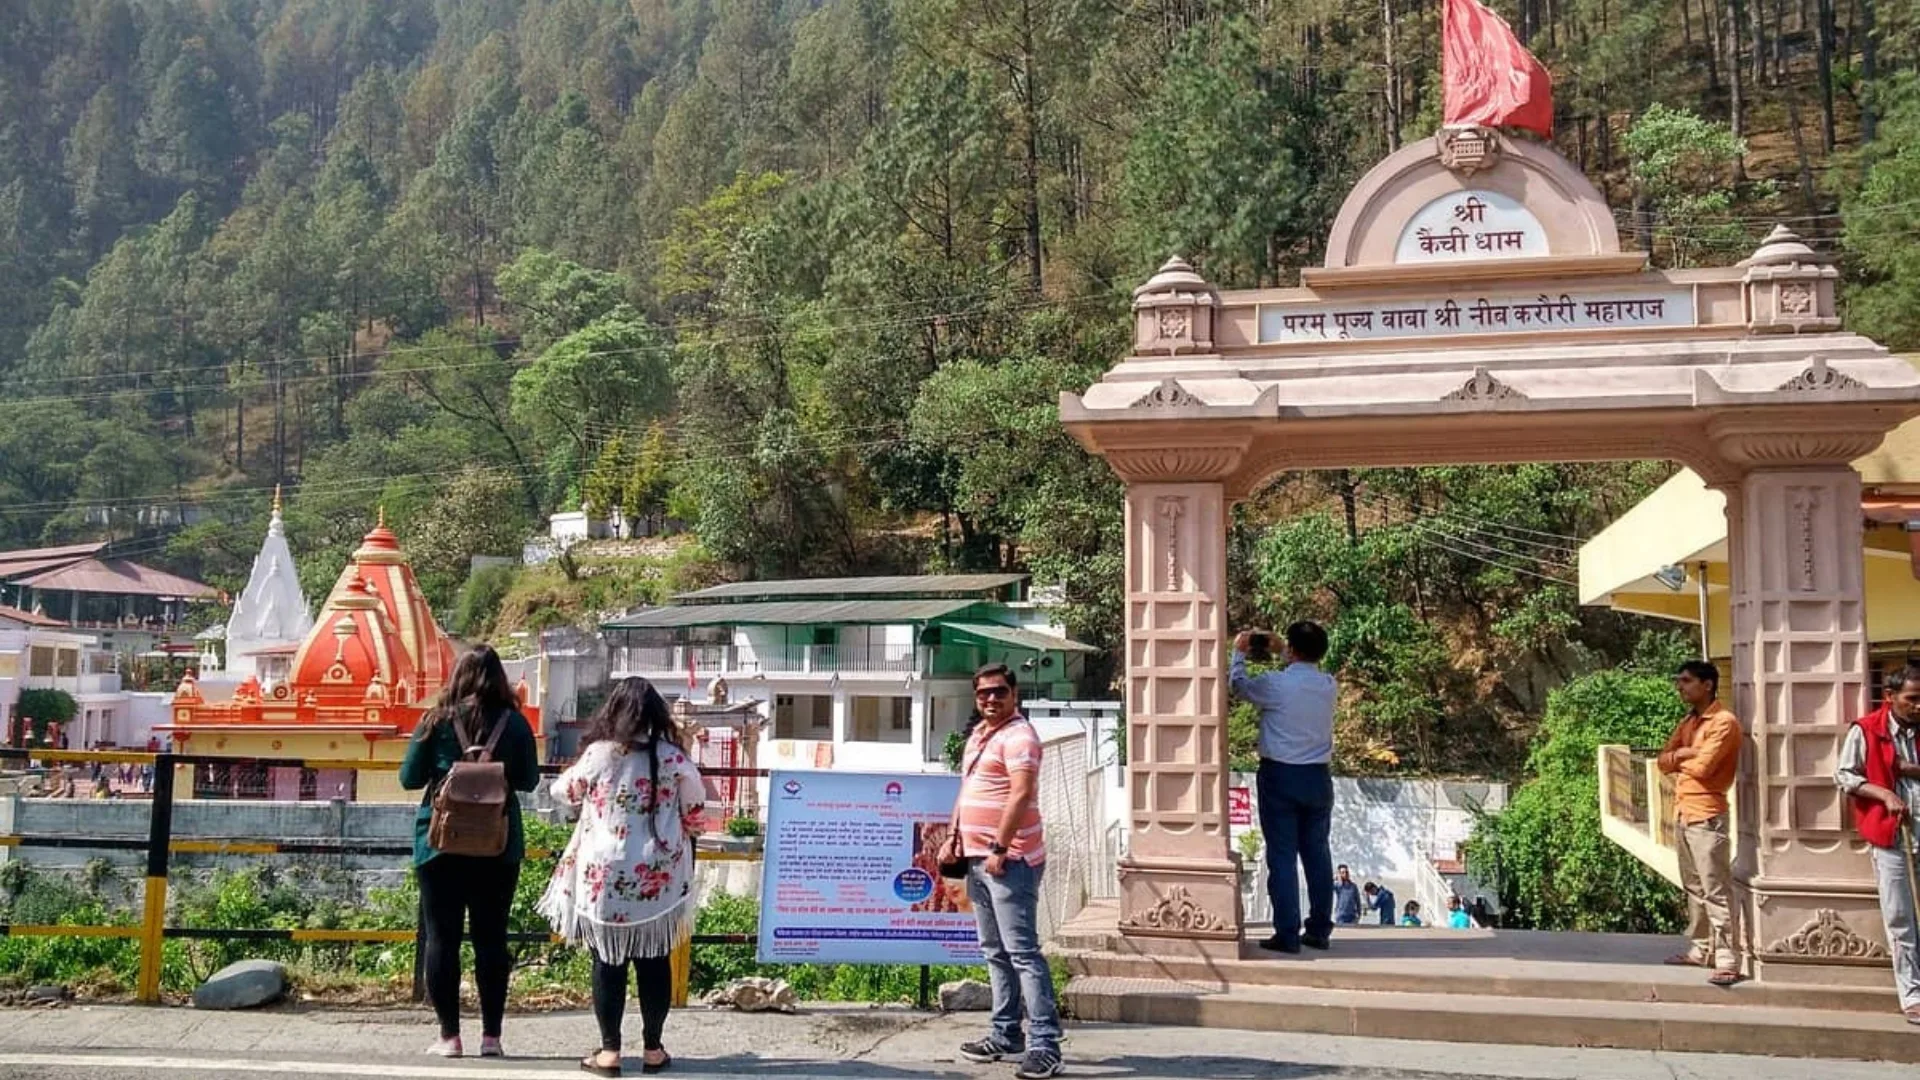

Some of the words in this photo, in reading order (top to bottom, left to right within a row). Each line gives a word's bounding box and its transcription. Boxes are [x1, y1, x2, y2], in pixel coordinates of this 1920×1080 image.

[1455, 196, 1487, 222] श्री
[1475, 231, 1524, 251] धाम
[1283, 314, 1325, 338] परम्
[1333, 311, 1374, 338] पूज्य
[1435, 300, 1461, 327] श्री
[1513, 294, 1576, 324] करौरी
[1584, 299, 1664, 322] महाराज
